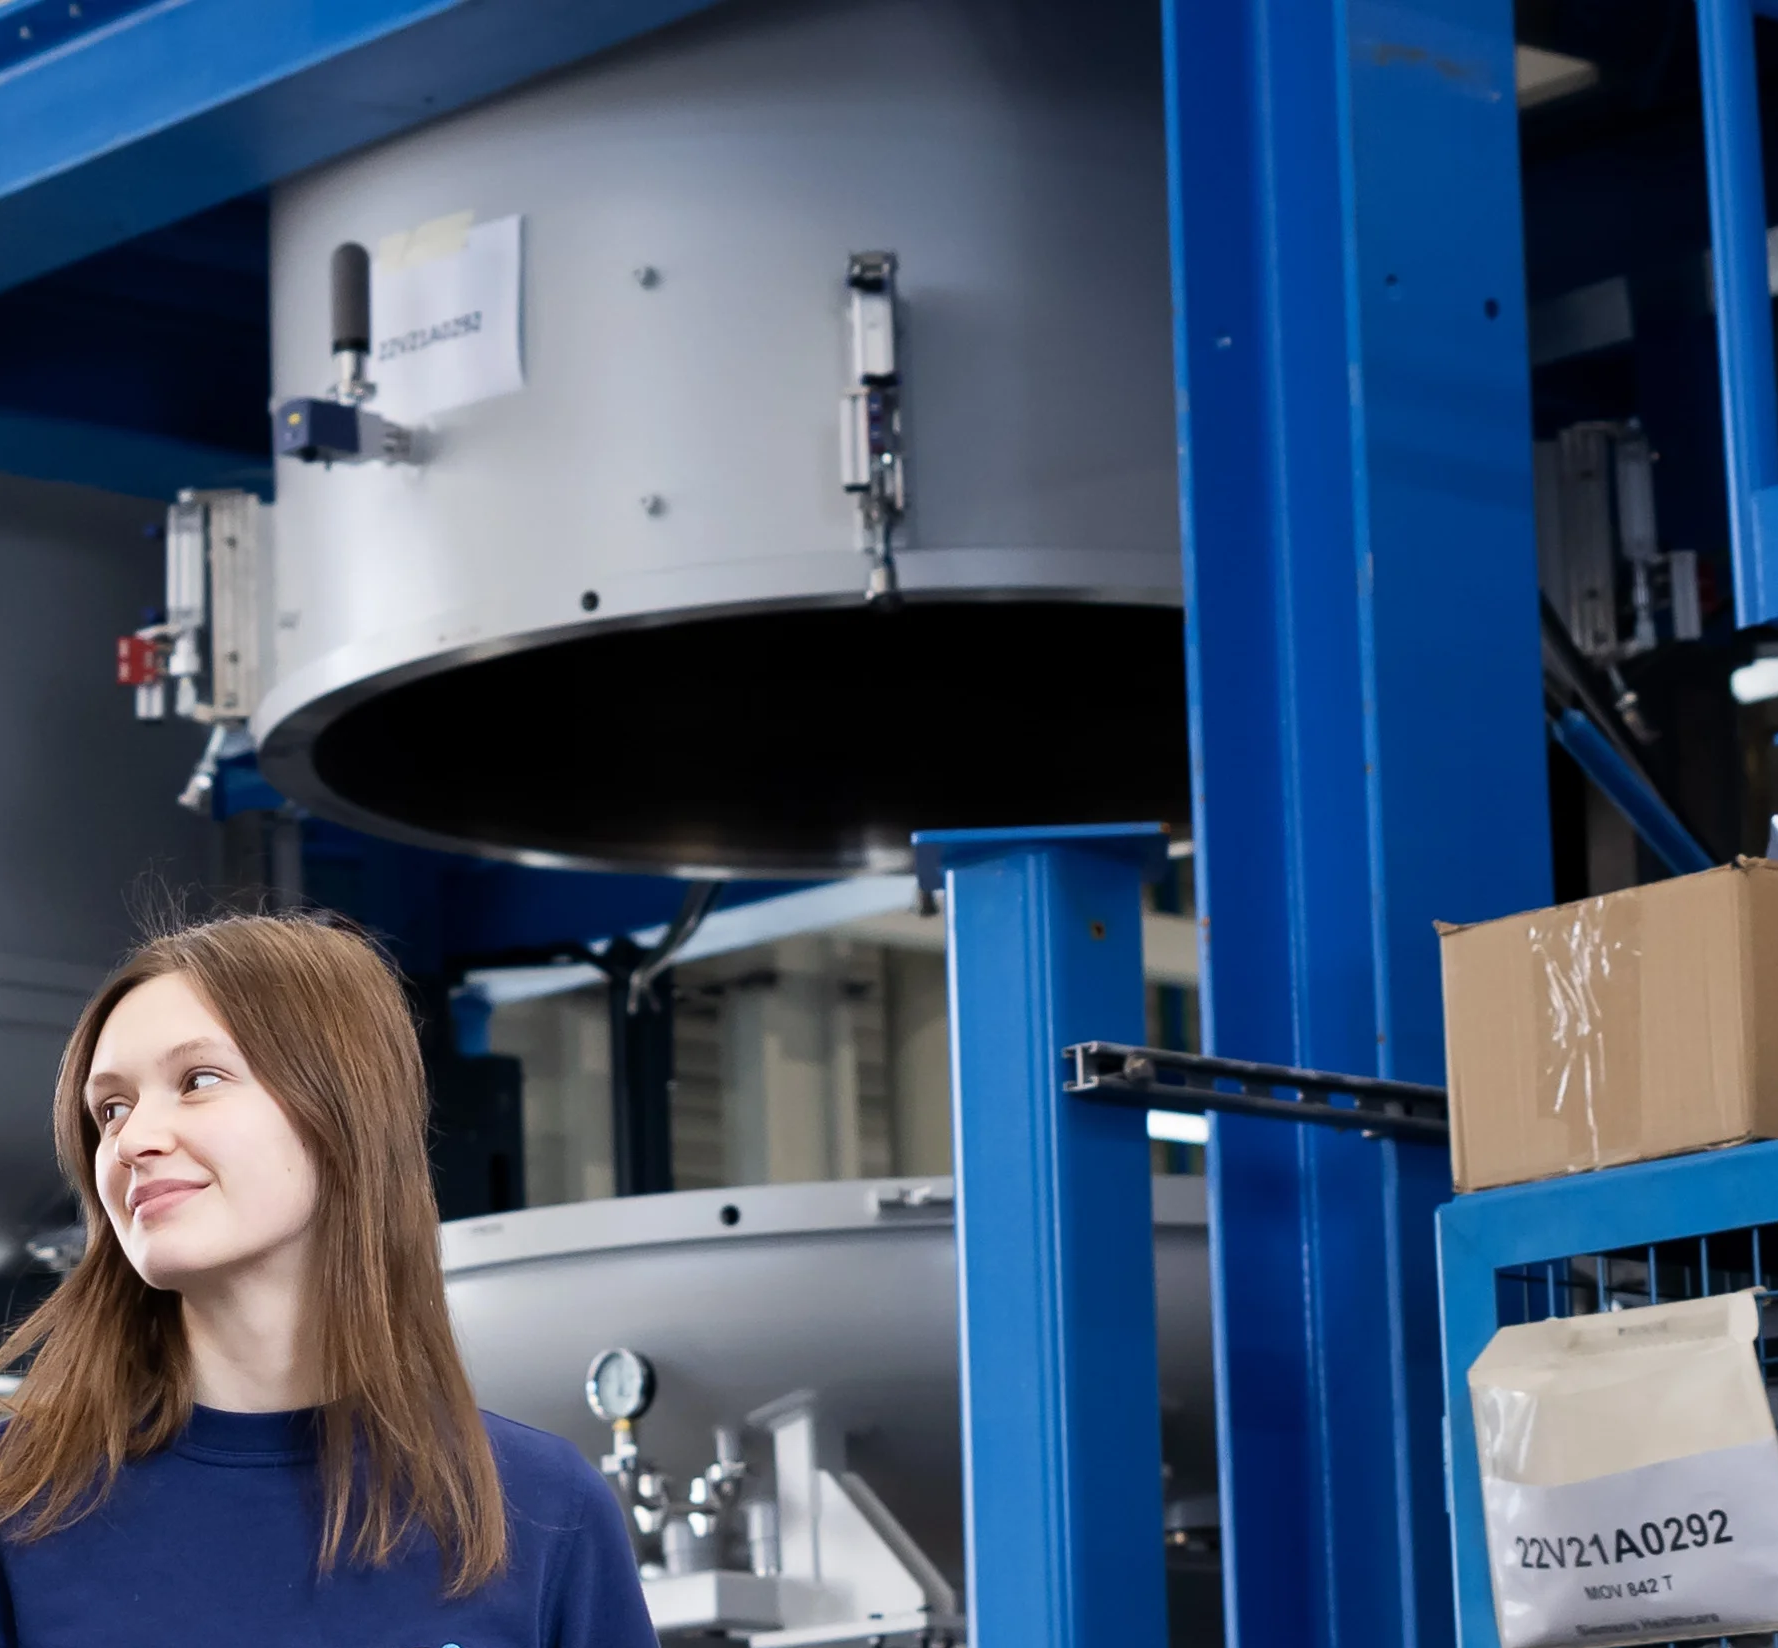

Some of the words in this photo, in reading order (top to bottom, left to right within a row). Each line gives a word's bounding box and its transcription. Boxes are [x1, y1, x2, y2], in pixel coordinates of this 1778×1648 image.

[1515, 1509, 1734, 1569] 22V21A0292
[1584, 1584, 1623, 1600] MOV
[1627, 1578, 1659, 1597] 842
[1661, 1574, 1672, 1590] T
